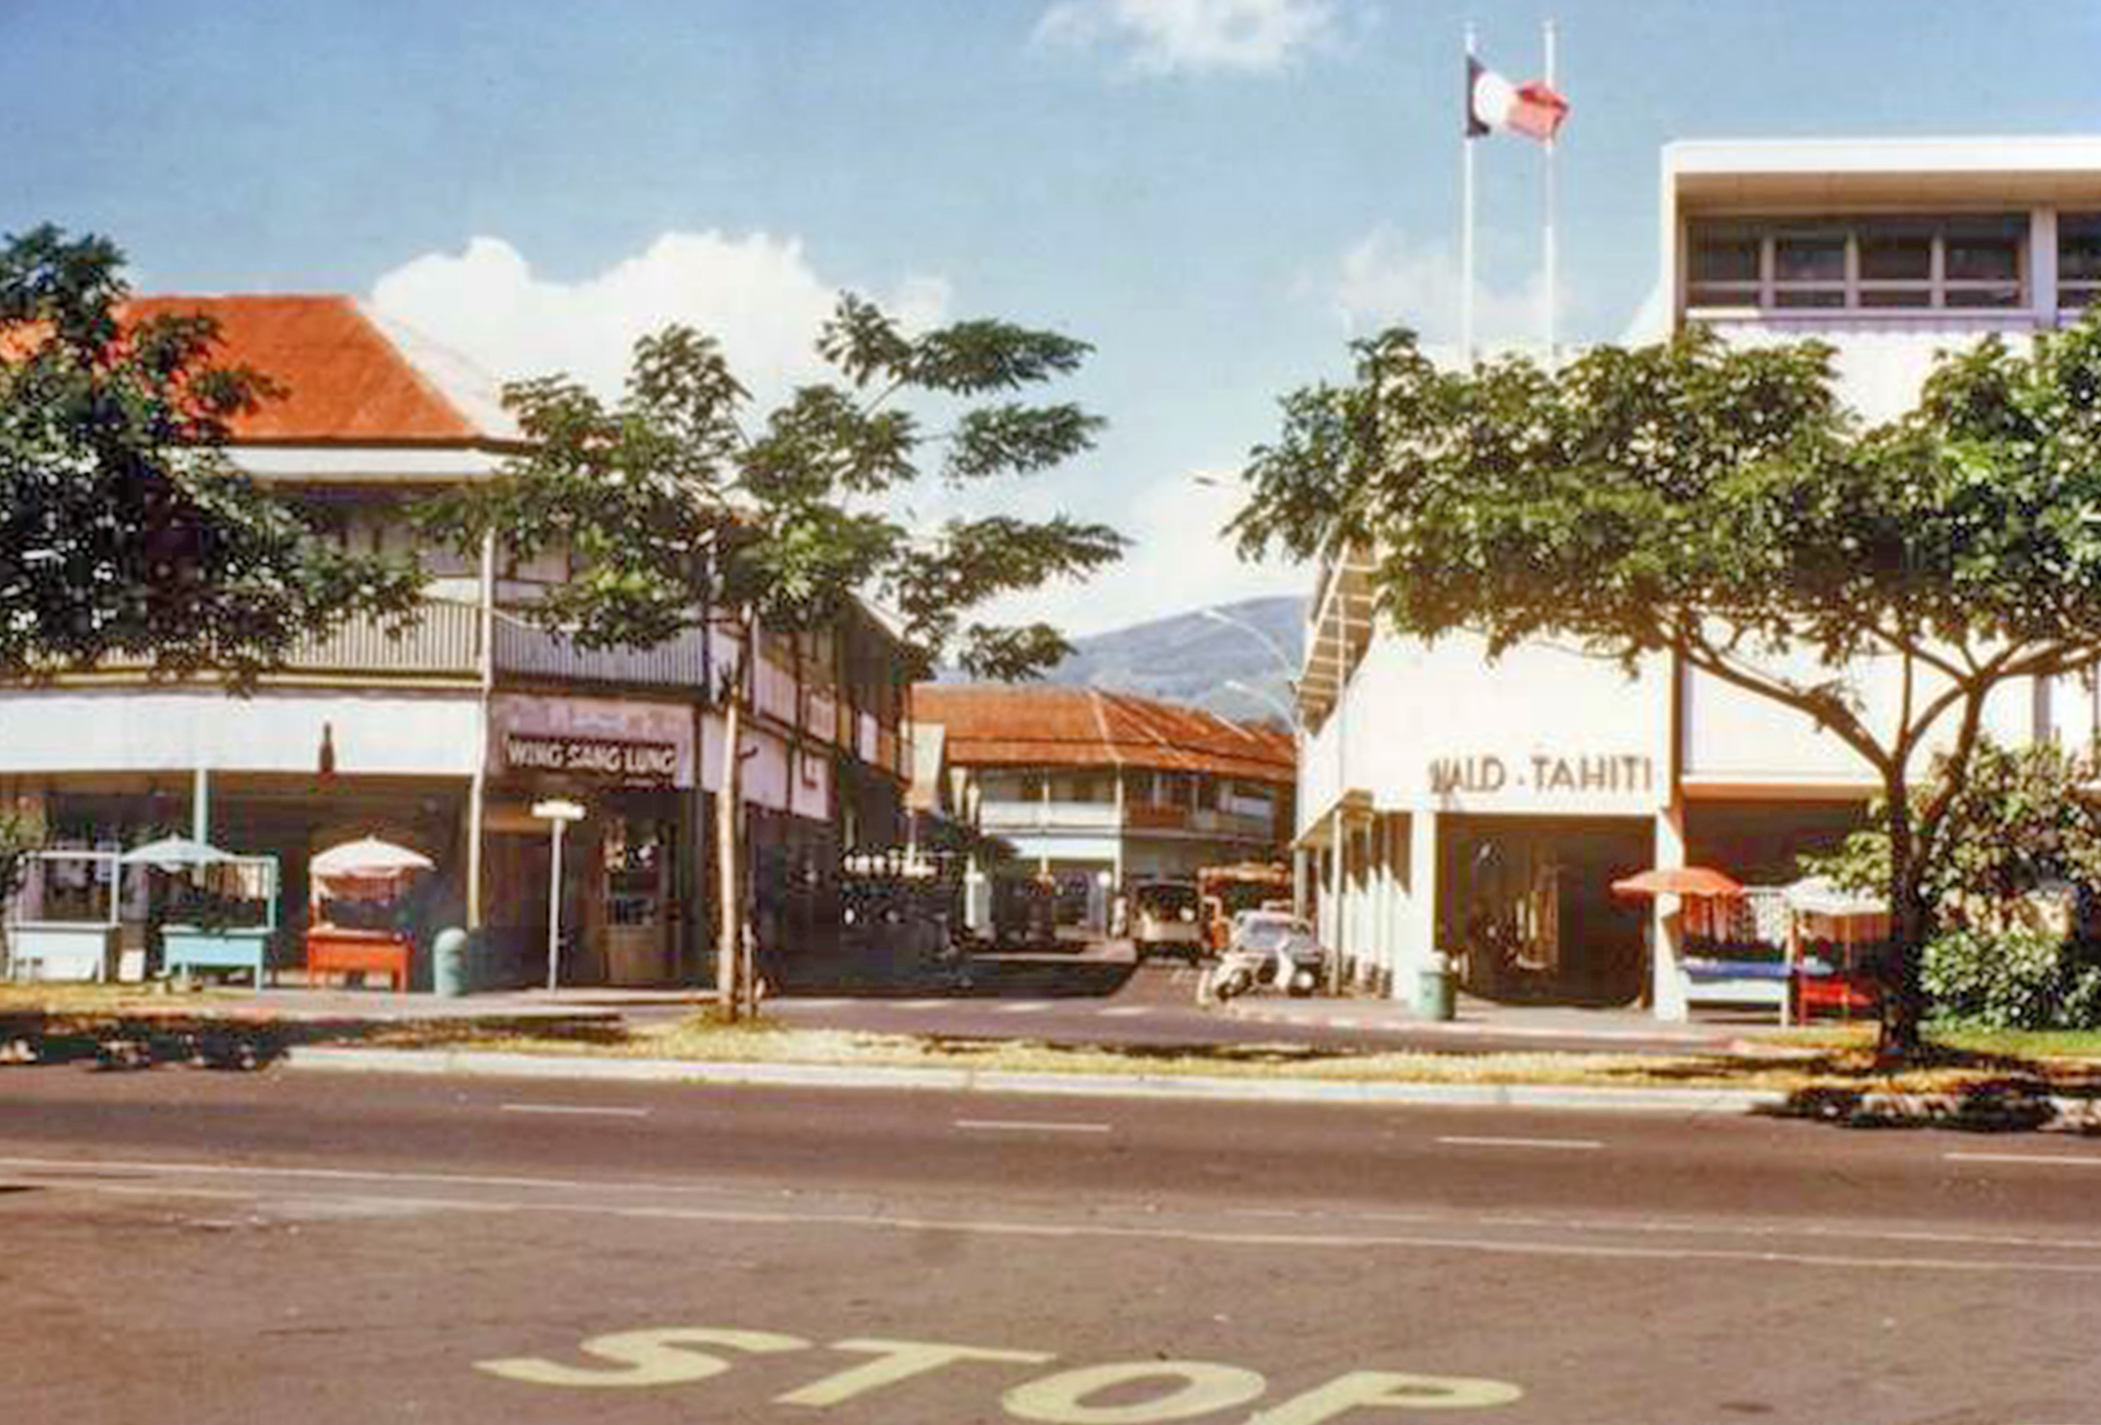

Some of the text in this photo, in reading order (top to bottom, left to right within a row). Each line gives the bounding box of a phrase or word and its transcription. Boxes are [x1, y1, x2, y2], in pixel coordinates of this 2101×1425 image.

[508, 743, 676, 776] WING SANG LUNG
[1532, 756, 1652, 791] TAHITI
[475, 1328, 1523, 1425] STOP
